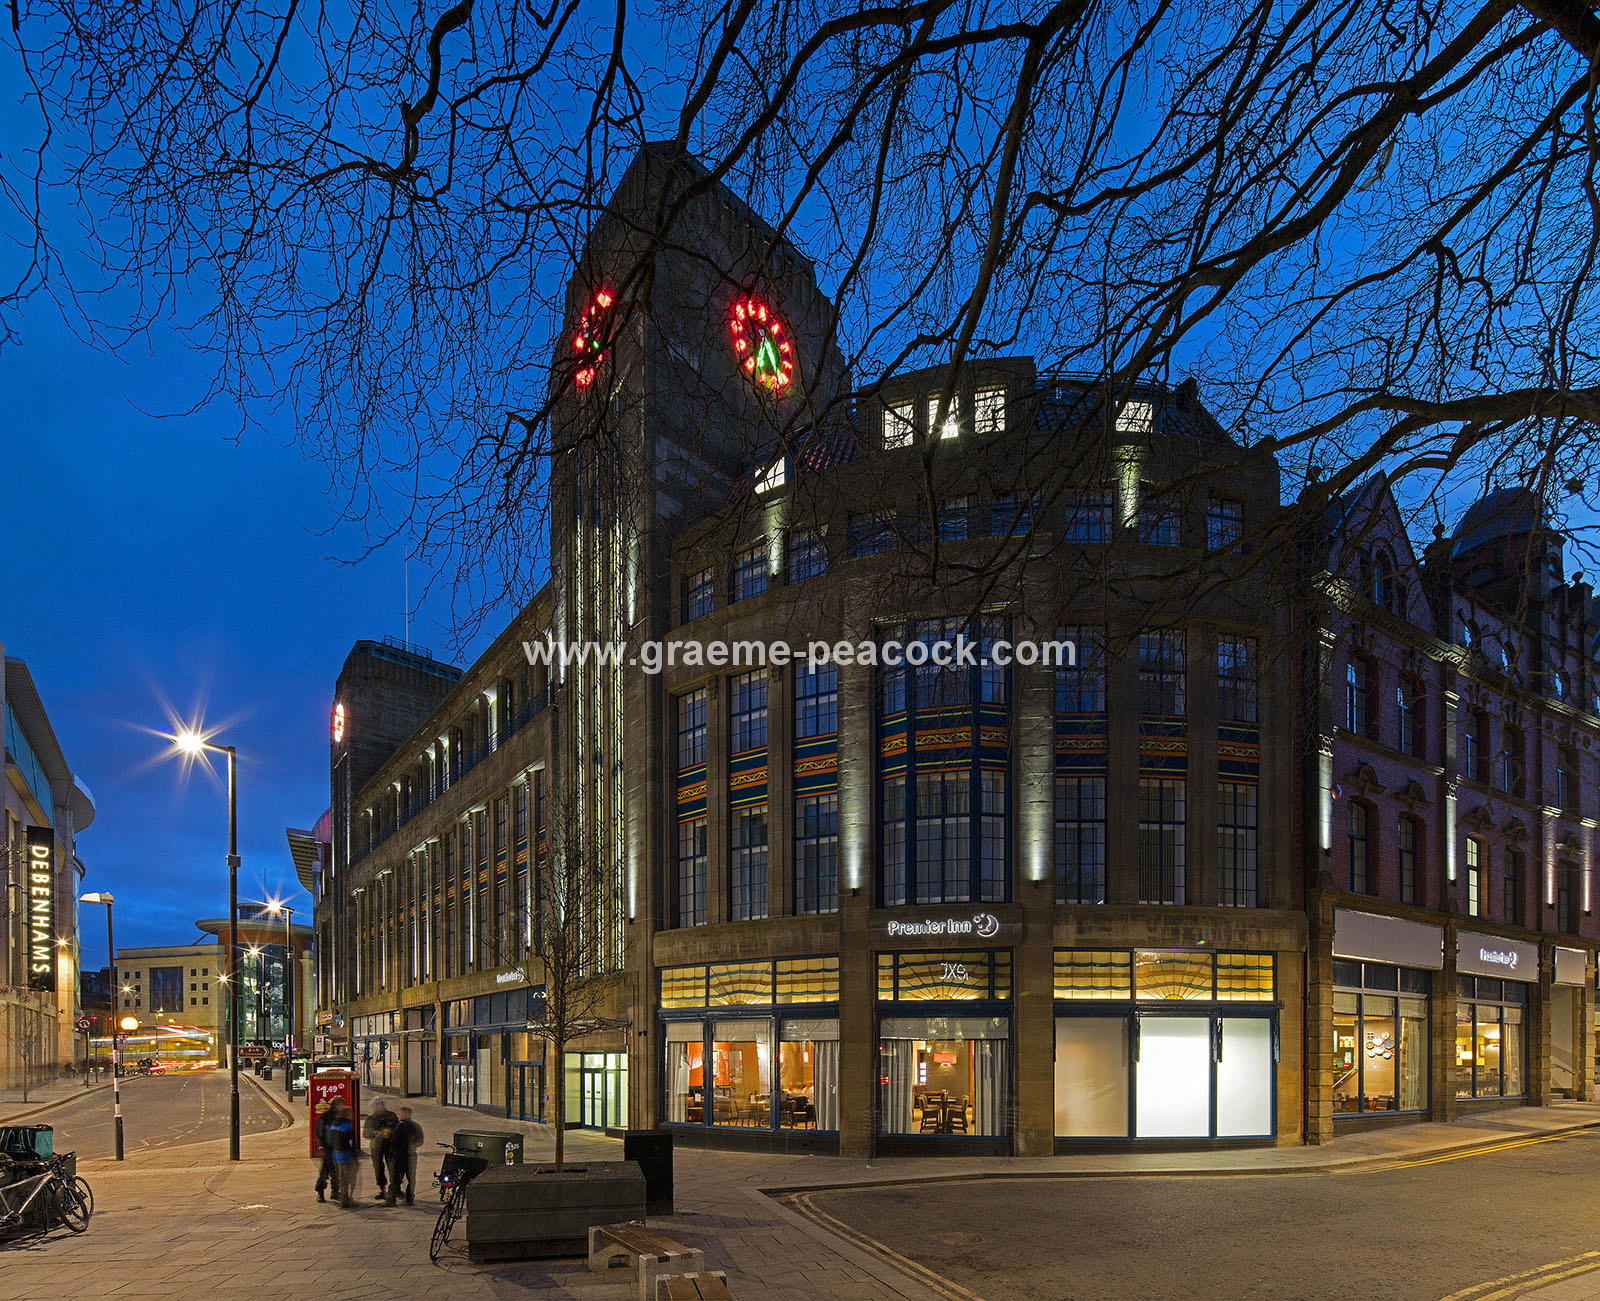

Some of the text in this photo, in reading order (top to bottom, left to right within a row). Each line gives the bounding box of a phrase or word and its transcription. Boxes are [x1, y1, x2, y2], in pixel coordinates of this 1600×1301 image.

[31, 845, 50, 973] DEBENHAMS
[888, 919, 972, 936] Premier Inn
[316, 1085, 338, 1098] £1.49
